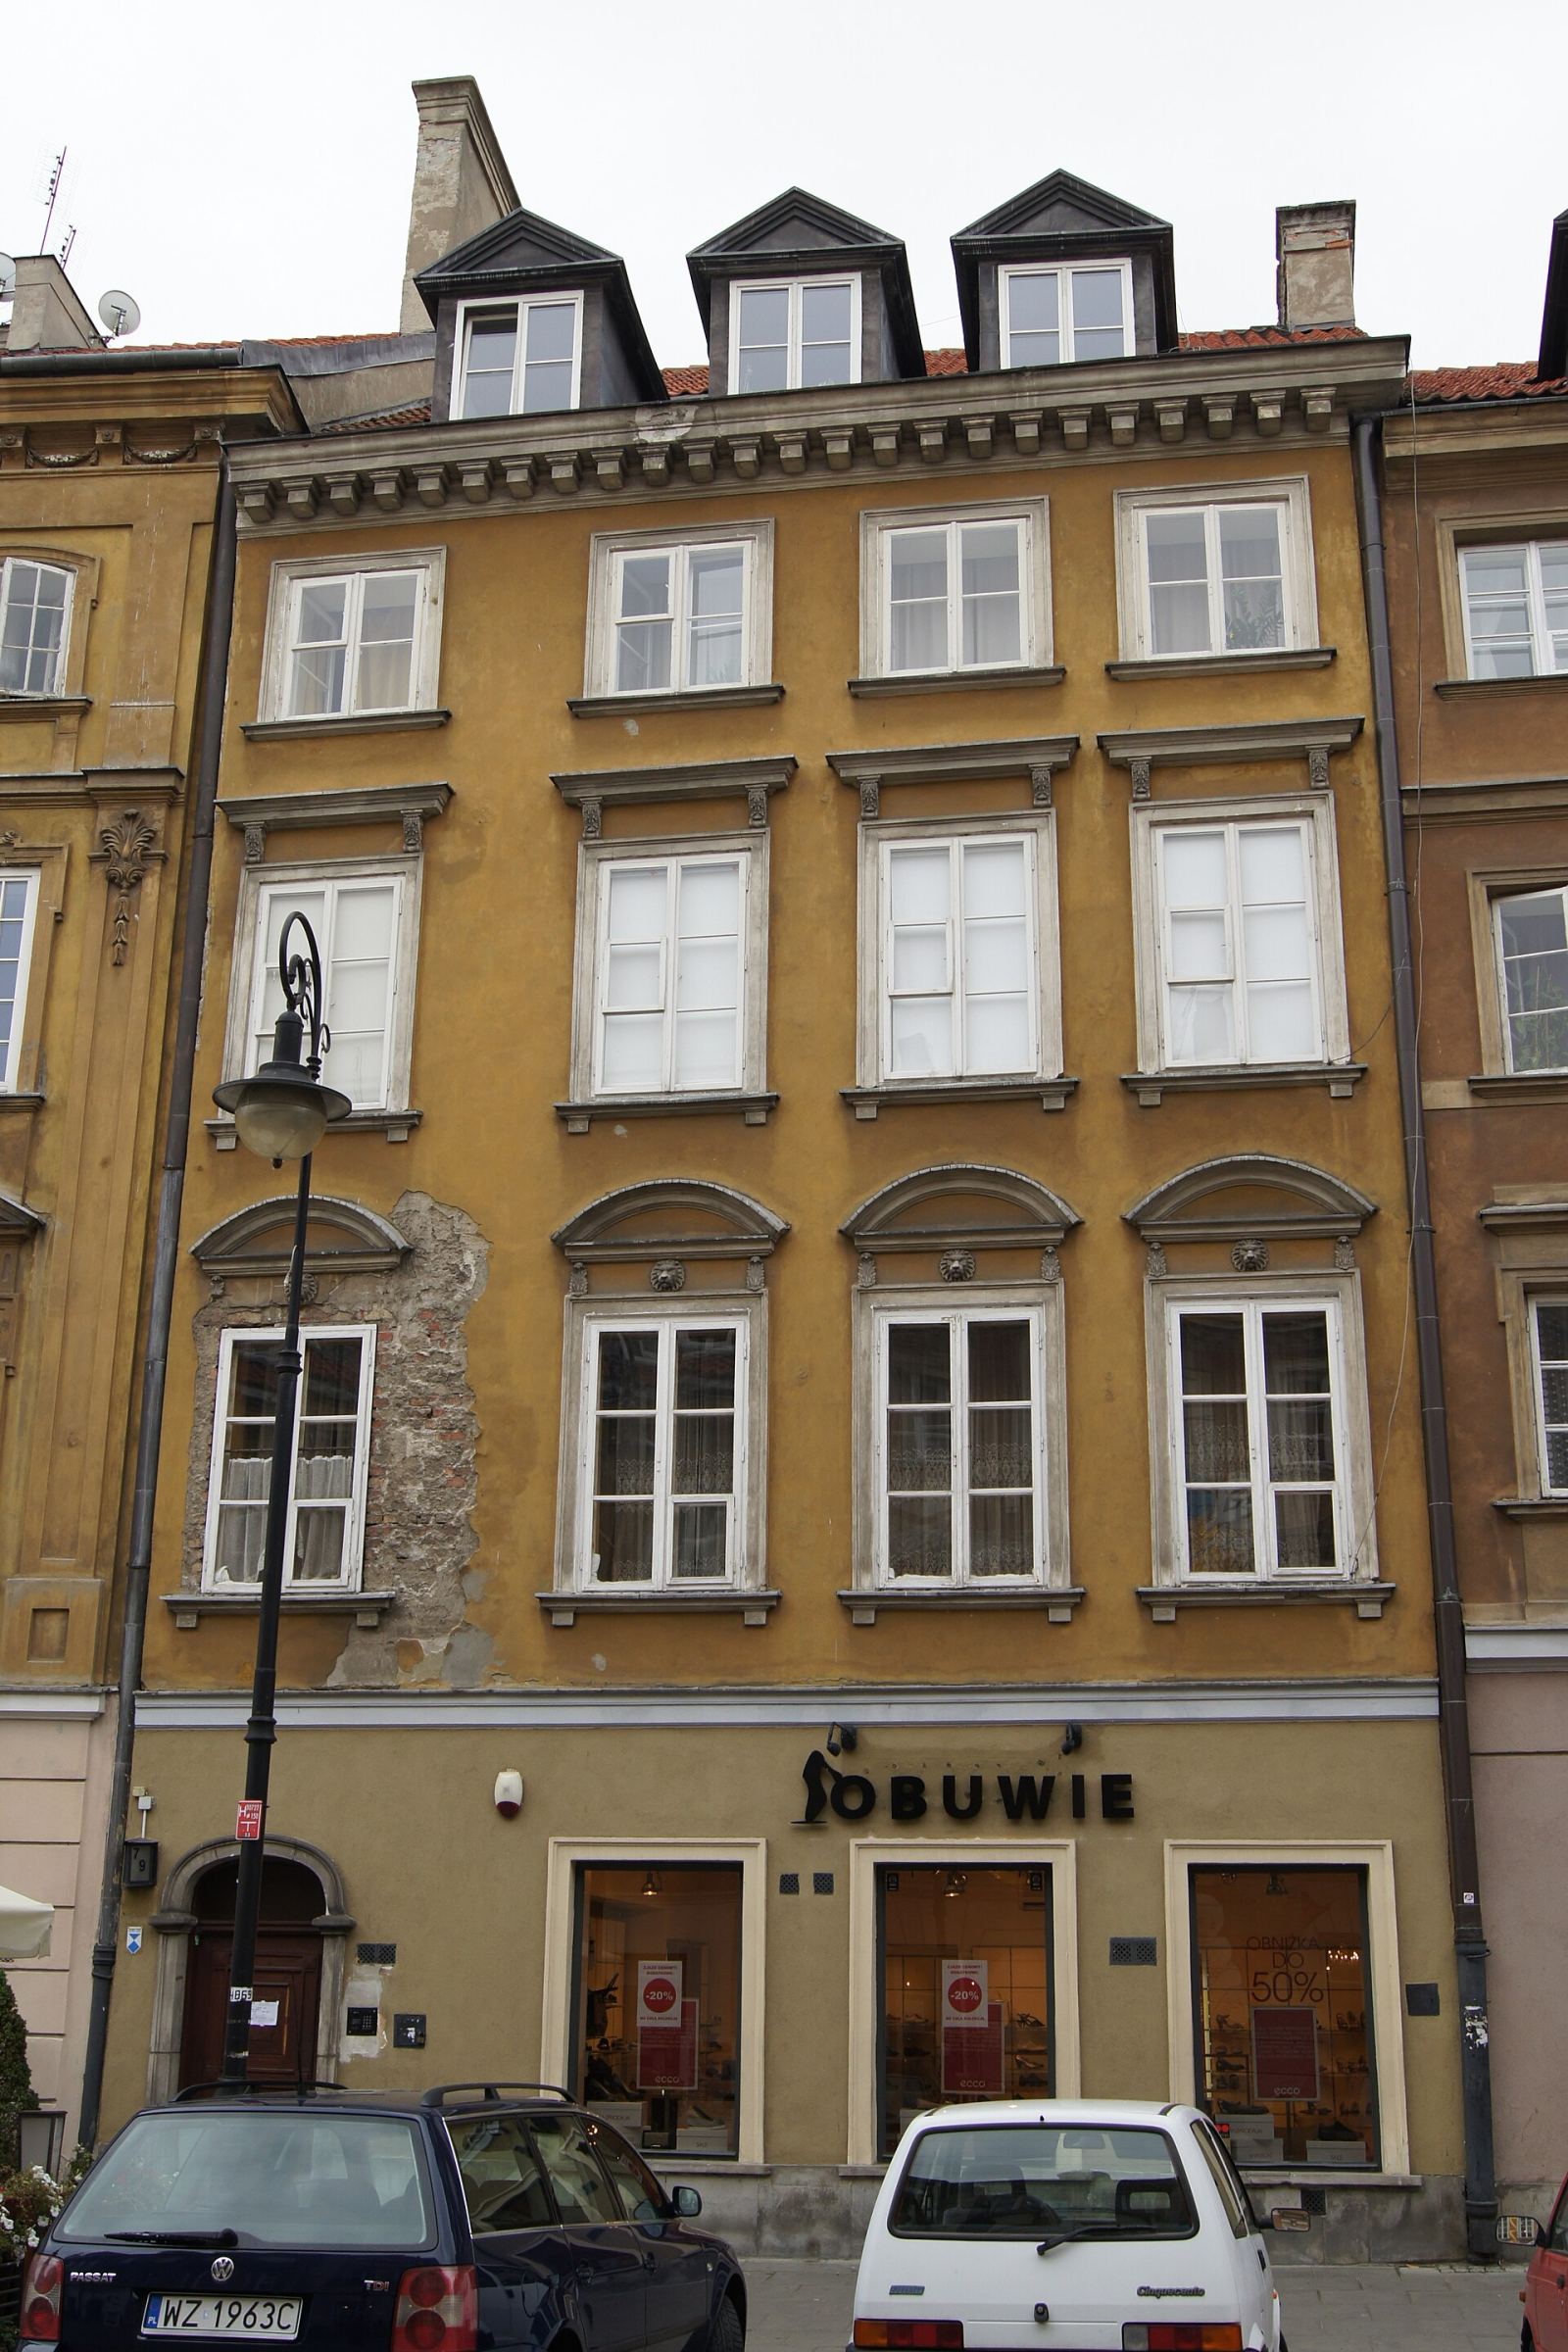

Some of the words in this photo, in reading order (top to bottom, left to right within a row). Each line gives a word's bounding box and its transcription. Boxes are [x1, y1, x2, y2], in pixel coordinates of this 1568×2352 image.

[830, 1775, 1135, 1820] OBUWIE
[139, 1860, 146, 1872] 9
[1272, 1951, 1304, 1969] DO
[1251, 1972, 1324, 2002] 50%
[646, 1991, 673, 2000] -20%
[951, 1991, 979, 2000] -20%
[70, 2272, 117, 2282] PASSAT
[364, 2279, 390, 2291] TDI
[147, 2316, 157, 2325] PL
[163, 2299, 203, 2328] WZ
[214, 2300, 294, 2330] 1963C
